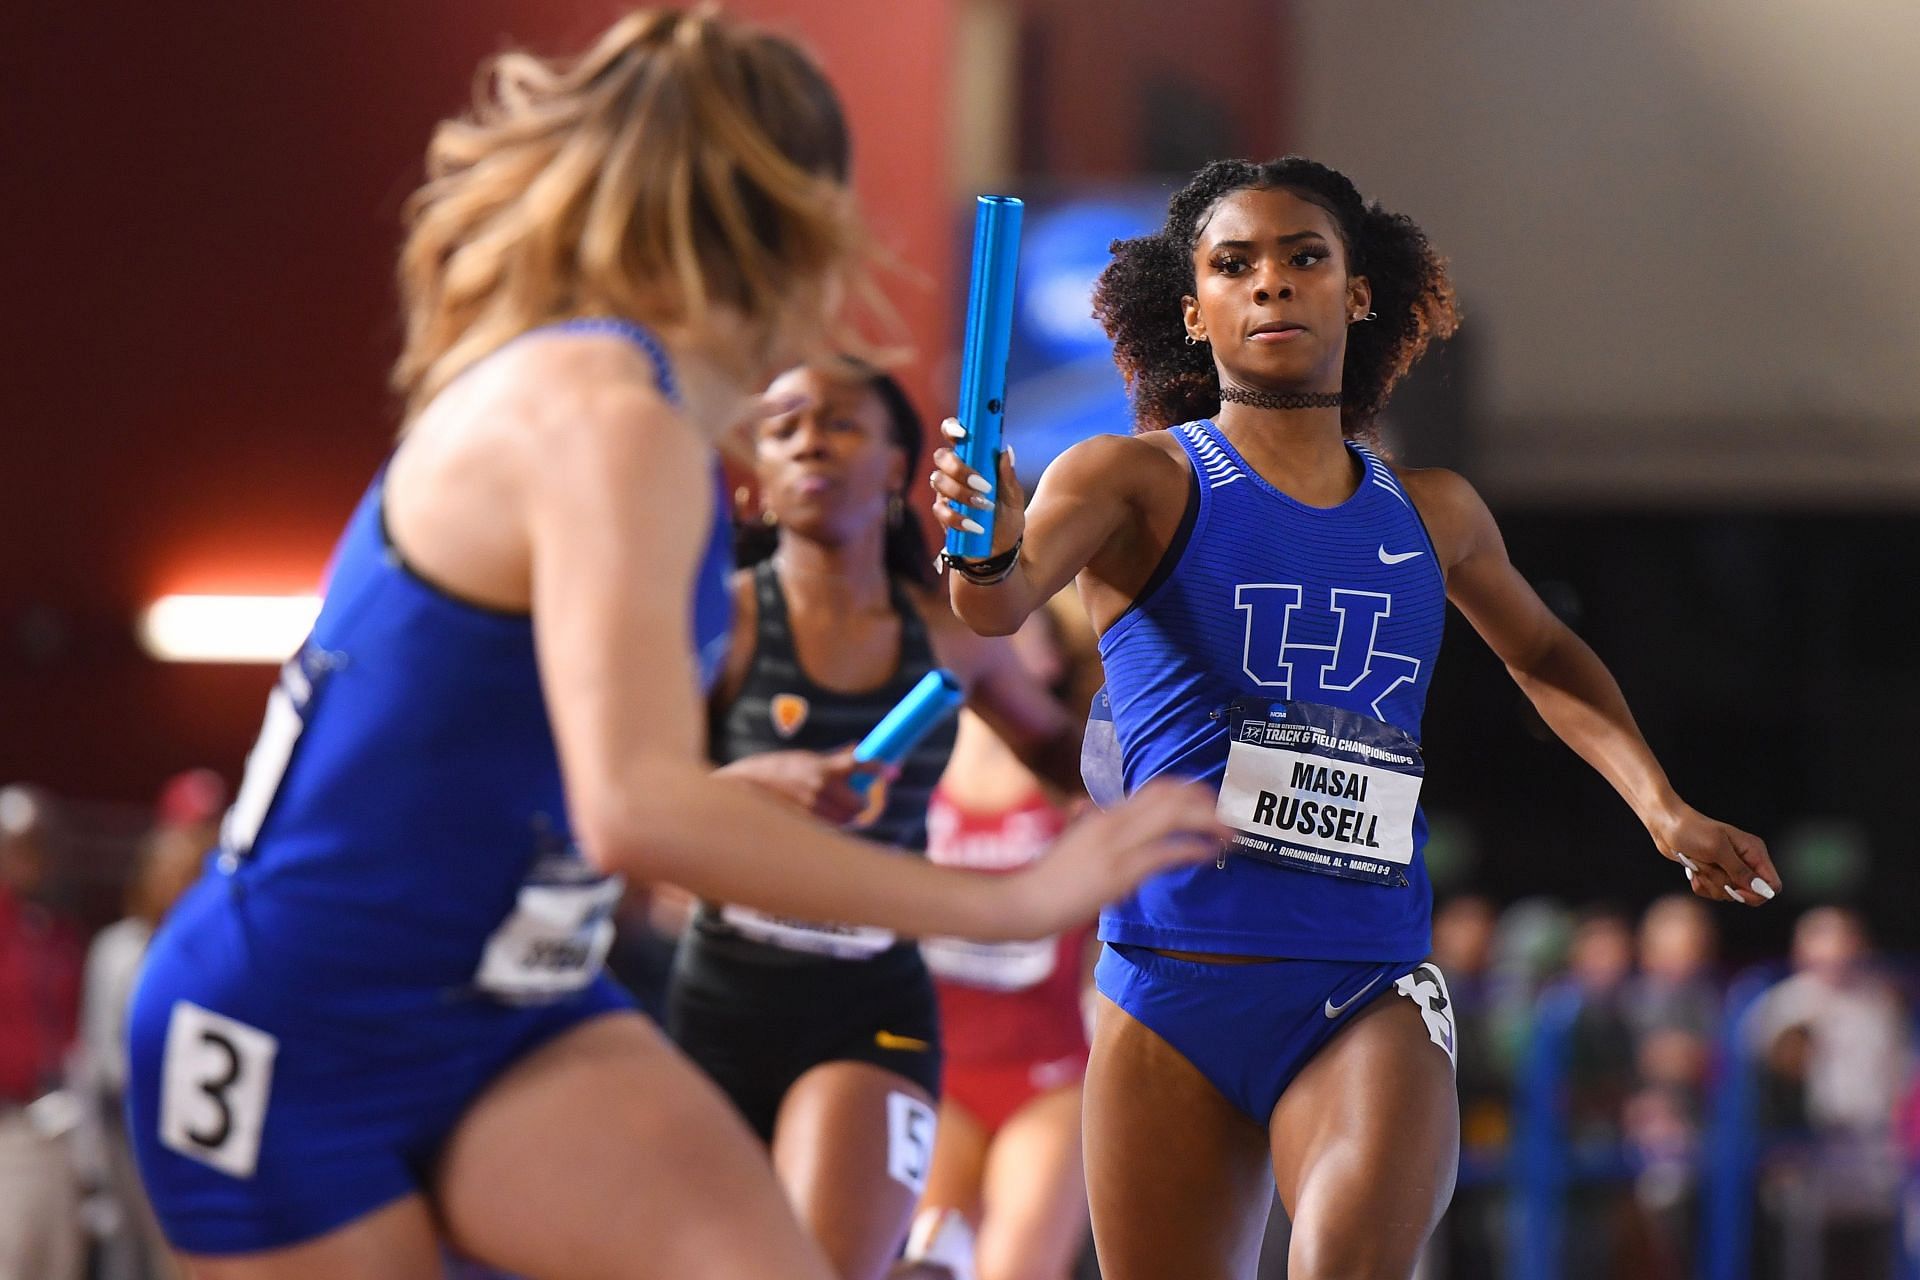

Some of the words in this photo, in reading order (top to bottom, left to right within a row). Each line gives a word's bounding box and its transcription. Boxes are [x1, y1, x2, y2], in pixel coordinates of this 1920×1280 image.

[1265, 728, 1301, 743] TRACK
[1302, 732, 1310, 743] &
[1311, 733, 1337, 748] FIELD
[1338, 739, 1414, 765] CHAMPIONSHIPS
[1290, 762, 1368, 802] MASAI
[1253, 790, 1380, 848] RUSSELL
[1232, 834, 1268, 851] DIVISION
[1279, 846, 1331, 866] BIRMINGHAM,
[1333, 859, 1342, 868] AL
[1349, 860, 1377, 873] MARCH
[1377, 865, 1391, 875] 8-9
[187, 1032, 239, 1149] 3
[907, 1109, 926, 1179] 5
